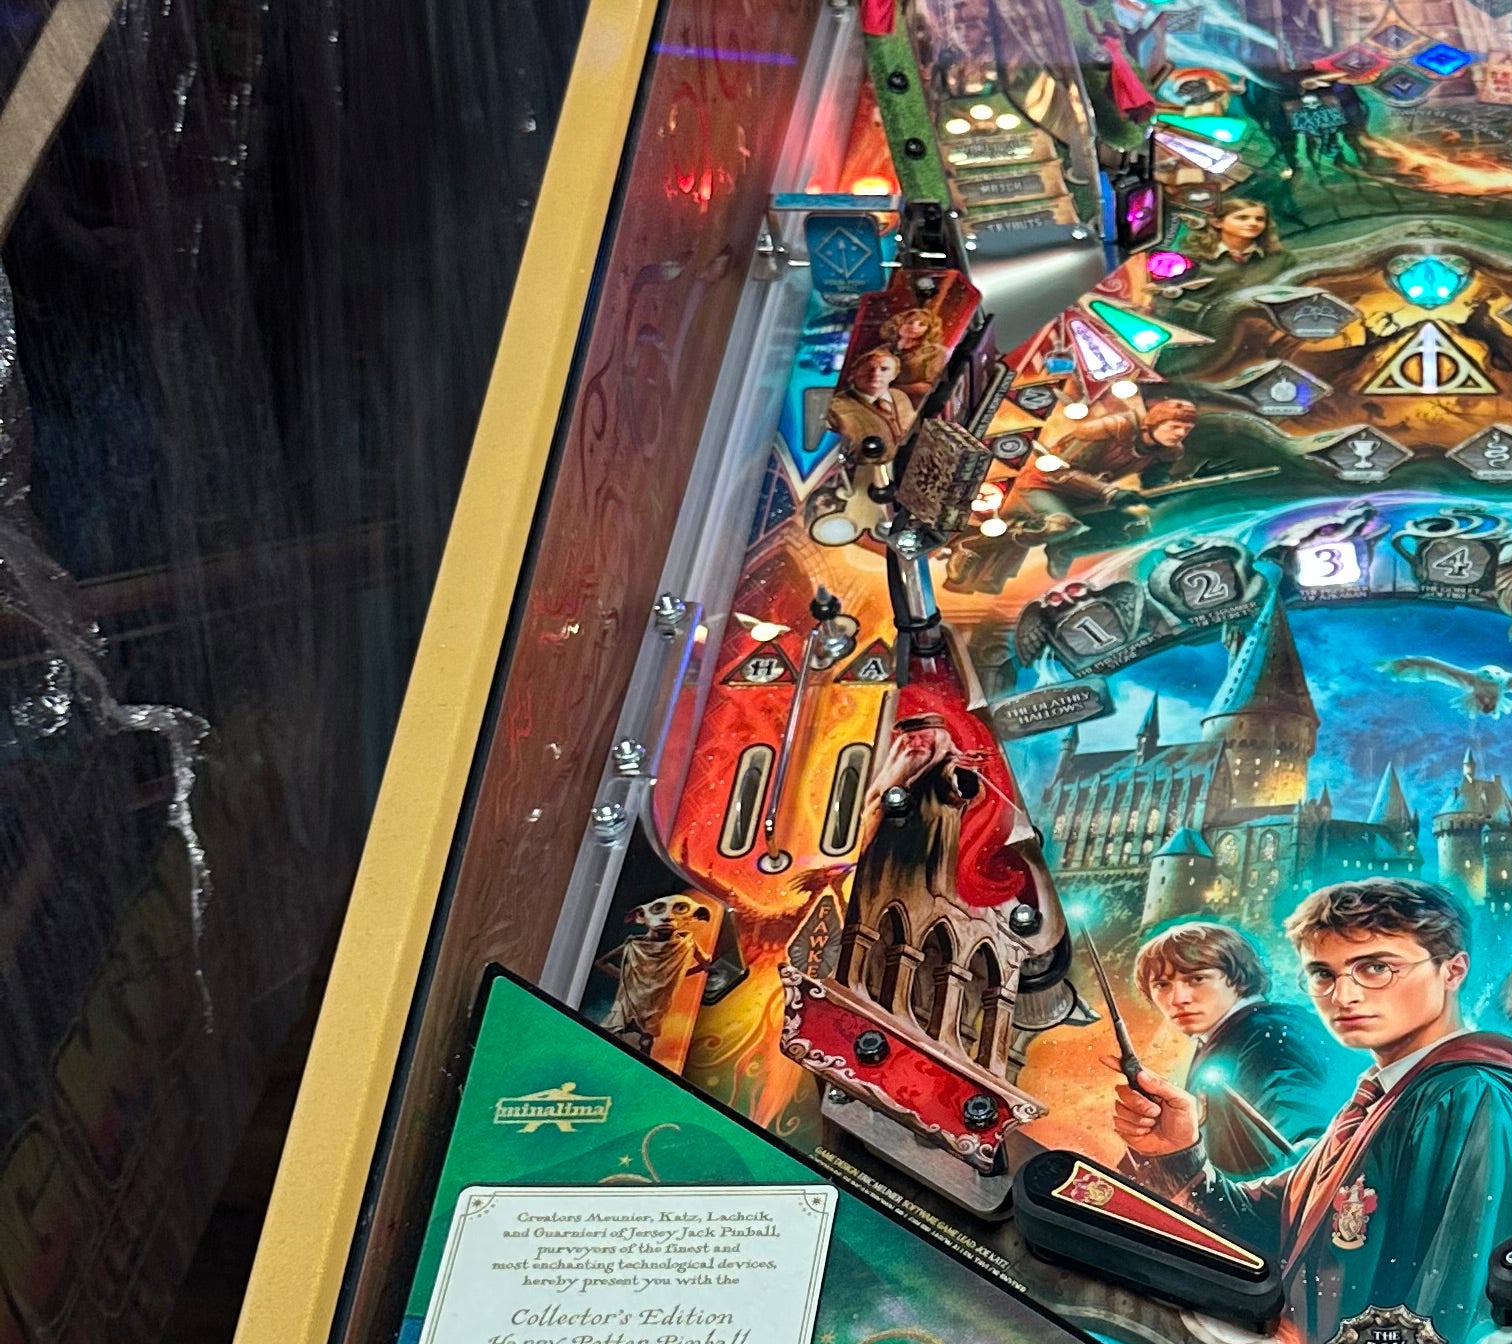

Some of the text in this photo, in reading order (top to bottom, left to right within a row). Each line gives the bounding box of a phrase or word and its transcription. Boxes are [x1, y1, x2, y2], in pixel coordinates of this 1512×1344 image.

[1314, 548, 1345, 578] 3
[1431, 545, 1474, 579] 4
[1184, 568, 1230, 606] 2
[1072, 615, 1117, 650] 1
[749, 658, 777, 678] H
[858, 658, 887, 678] A
[1018, 702, 1085, 725] HALLOWS
[807, 906, 832, 979] FAWKE
[498, 1102, 606, 1118] minalima
[517, 1211, 583, 1223] Creators
[585, 1211, 654, 1224] Meunier,
[658, 1211, 702, 1224] Katz,
[503, 1227, 530, 1239] and
[533, 1227, 606, 1239] Guarnieri
[624, 1227, 679, 1244] Jersey
[676, 1226, 715, 1241] Jack
[720, 1225, 780, 1238] Pinball,
[535, 1243, 741, 1261] purveyors of the finest and
[492, 1258, 778, 1274] most enchanting technological devices,
[522, 1275, 740, 1293] hereby present you with the
[511, 1304, 733, 1327] Collector's Edition
[1373, 1330, 1400, 1341] THE
